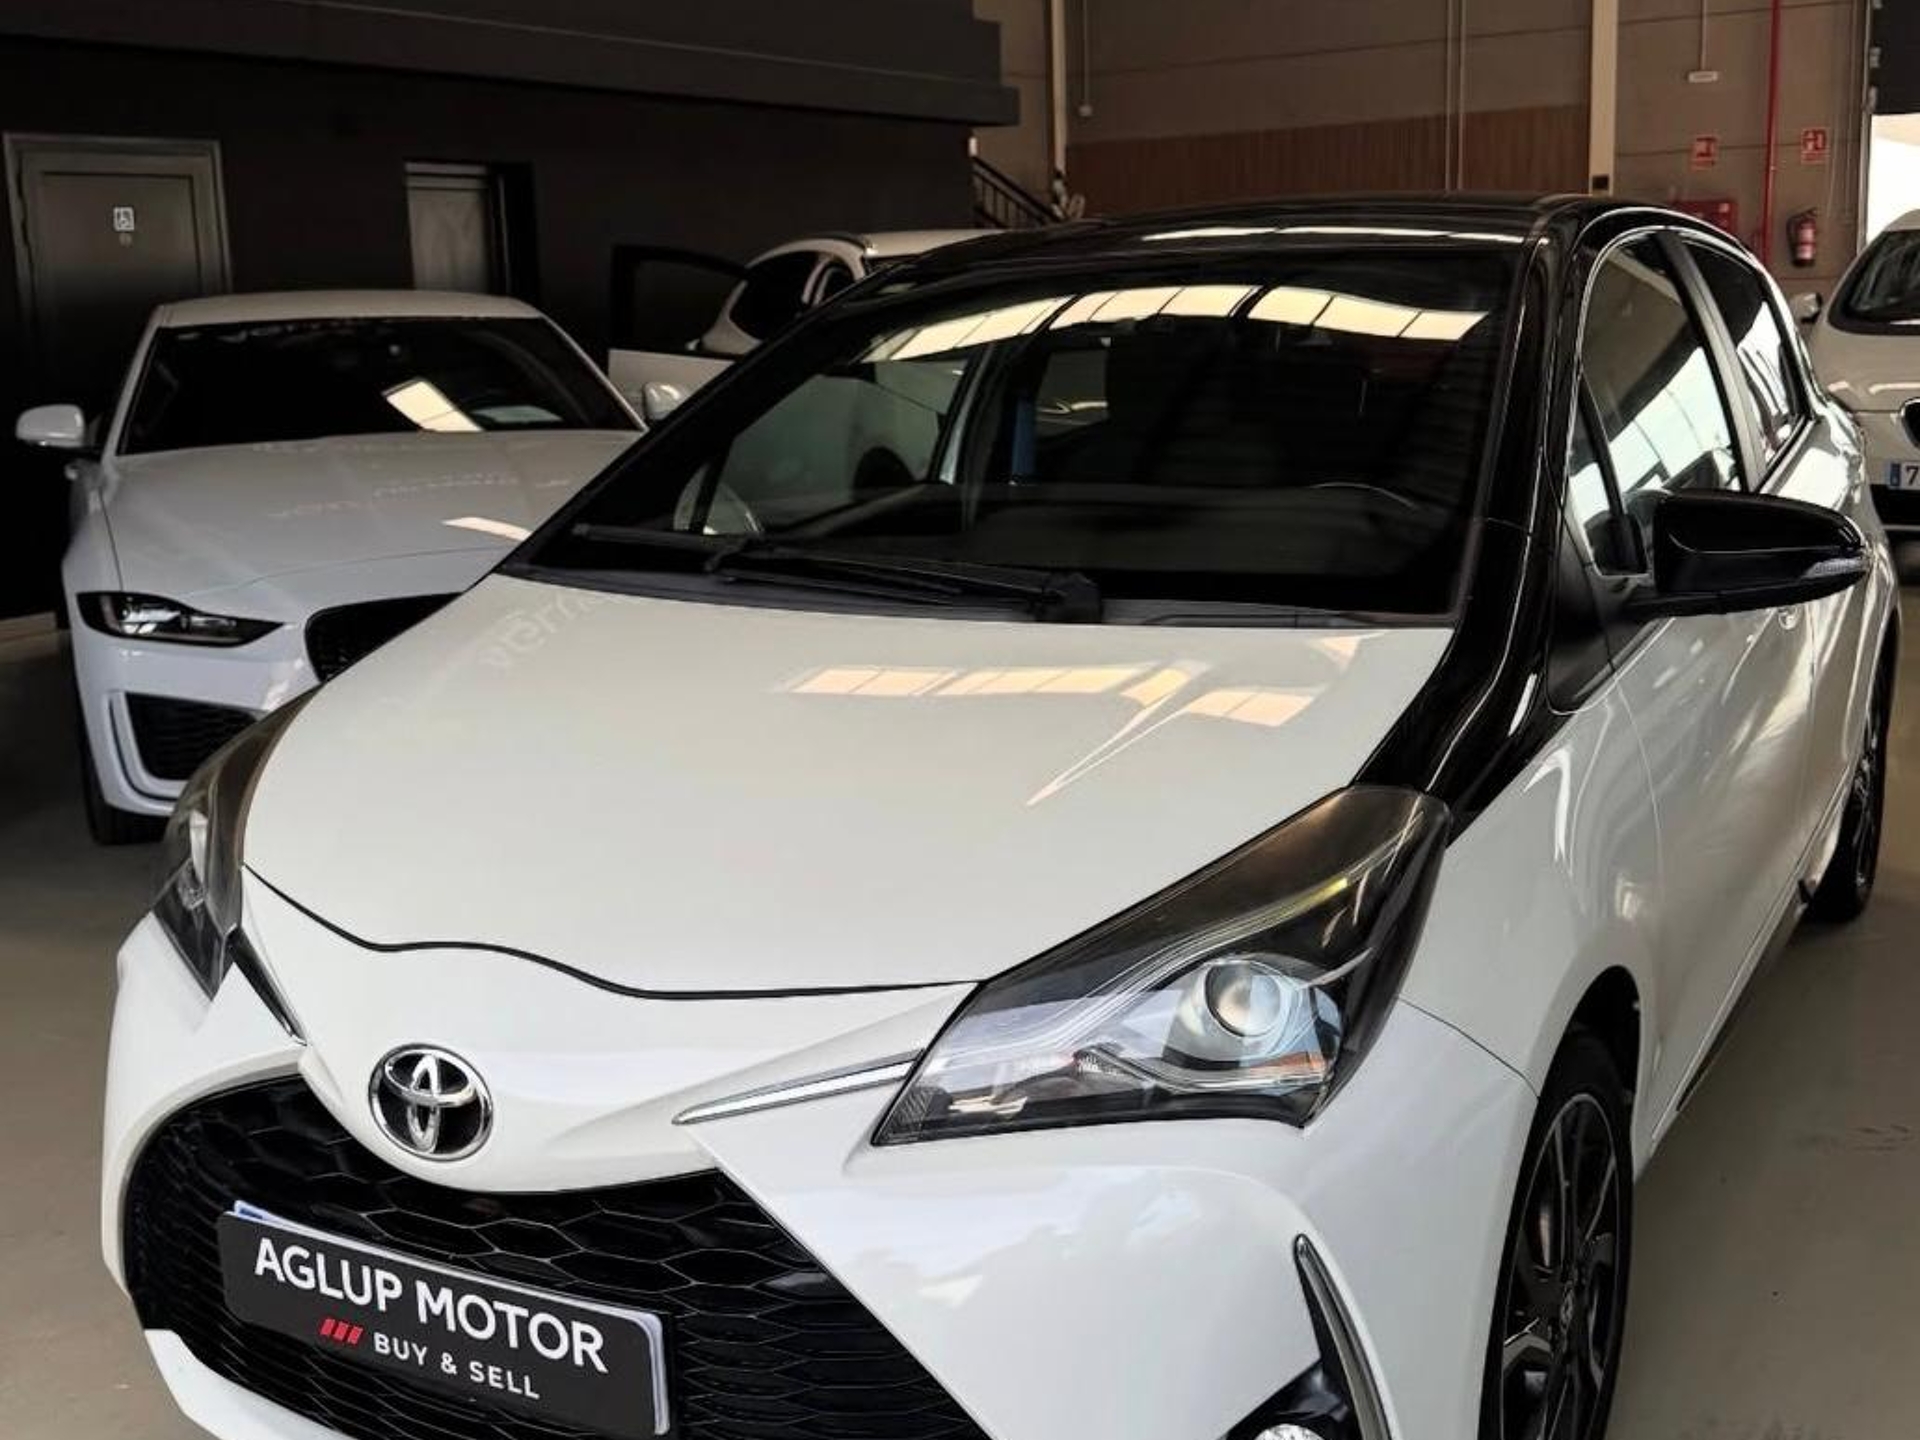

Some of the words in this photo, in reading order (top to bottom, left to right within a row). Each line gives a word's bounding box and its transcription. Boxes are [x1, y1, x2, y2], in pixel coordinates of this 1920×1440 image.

[254, 1237, 403, 1312] AGLUP
[415, 1280, 609, 1373] MOTOR
[373, 1332, 428, 1366] BUY
[440, 1352, 458, 1375] &
[469, 1361, 540, 1400] SELL
